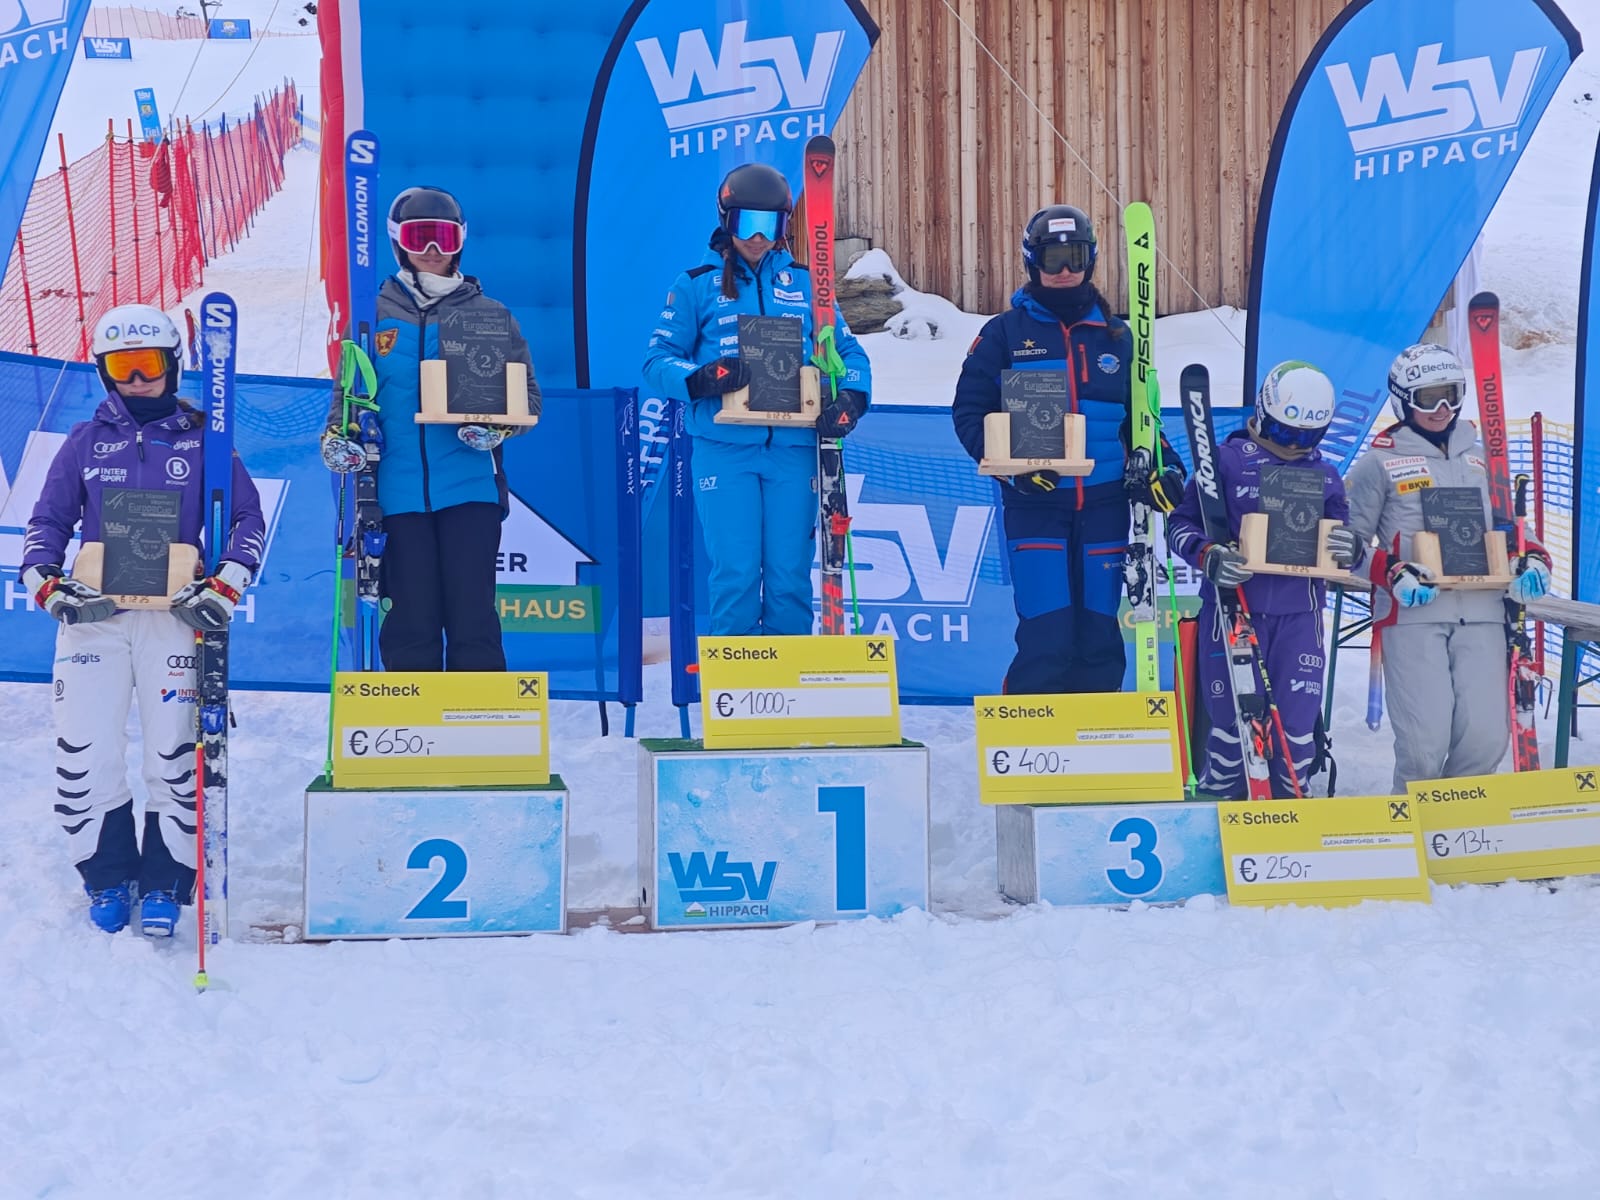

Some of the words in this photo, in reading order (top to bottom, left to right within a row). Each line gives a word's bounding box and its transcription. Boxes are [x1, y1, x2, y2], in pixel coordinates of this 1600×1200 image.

[635, 20, 846, 133] WSV
[1324, 42, 1548, 155] WSV
[670, 113, 826, 159] HIPPACH
[1354, 130, 1518, 181] HIPPACH
[355, 175, 369, 268] SALOMON
[815, 220, 831, 308] ROSSIGNOL
[127, 324, 160, 337] ACP
[1138, 262, 1150, 384] FISCHER
[480, 354, 491, 369] 2
[778, 360, 786, 373] 1
[1040, 410, 1050, 423] 3
[1304, 409, 1330, 421] ACP
[1483, 372, 1504, 458] ROSSIGNOL
[173, 439, 201, 450] digits
[1189, 390, 1219, 500] NORDICA
[100, 475, 127, 483] SPORT
[101, 467, 127, 475] INTER
[1408, 480, 1430, 490] BKW
[1296, 511, 1305, 525] 4
[1461, 527, 1471, 539] 5
[500, 599, 586, 619] HAUS
[72, 653, 101, 665] digits
[722, 647, 778, 660] Scheck
[1258, 659, 1271, 692] LEKI
[359, 683, 420, 697] Scheck
[715, 692, 734, 718] €
[998, 705, 1055, 718] Scheck
[349, 730, 369, 756] €
[992, 750, 1011, 775] €
[1431, 787, 1487, 803] Scheck
[1242, 811, 1299, 825] Scheck
[817, 786, 866, 911] 1
[1431, 833, 1450, 857] €
[1106, 817, 1163, 896] 3
[404, 838, 468, 919] 2
[667, 851, 779, 902] WSV
[1239, 857, 1258, 883] €
[709, 904, 769, 917] HIPPACH
